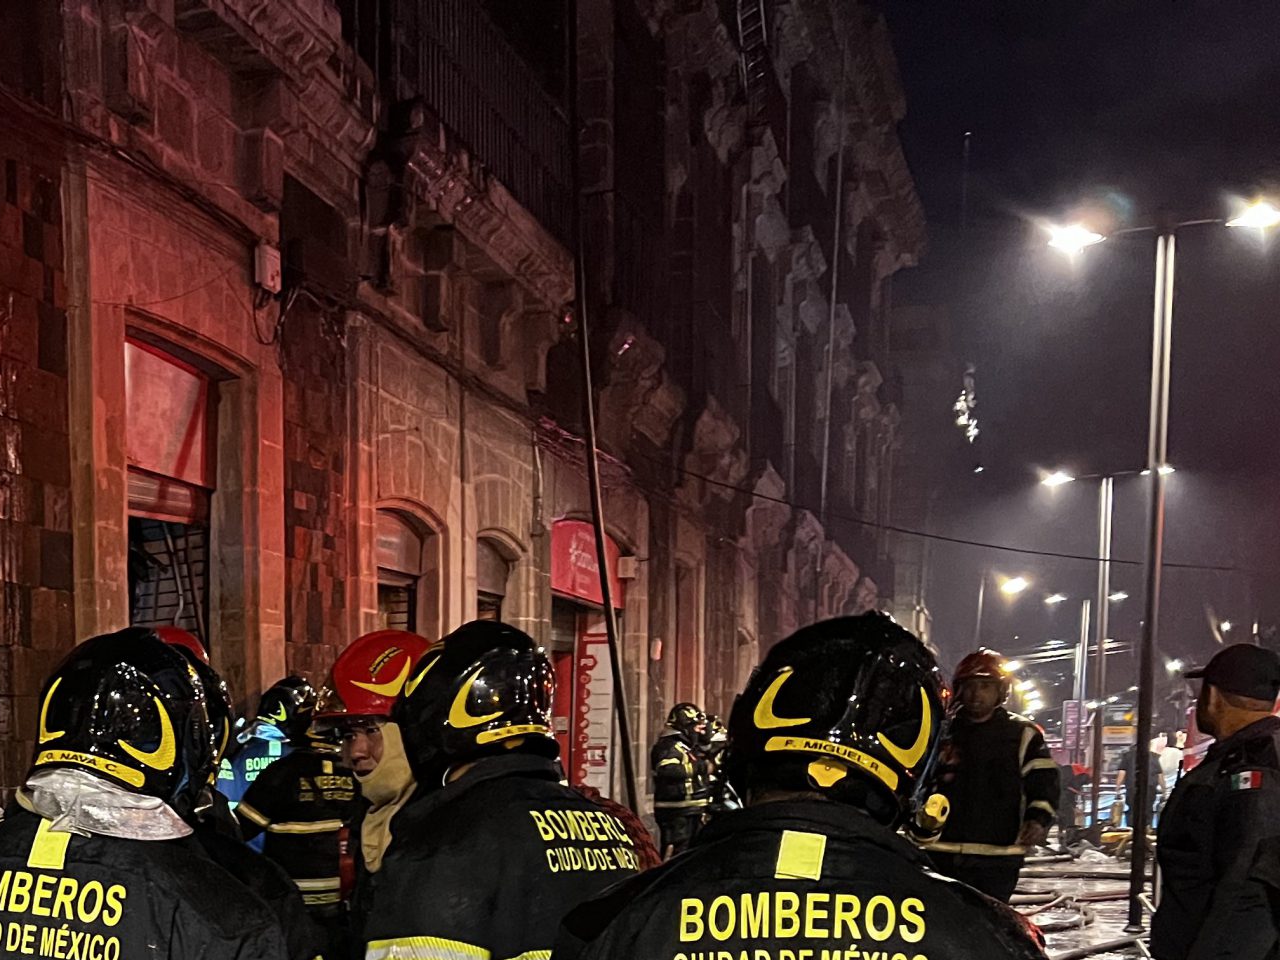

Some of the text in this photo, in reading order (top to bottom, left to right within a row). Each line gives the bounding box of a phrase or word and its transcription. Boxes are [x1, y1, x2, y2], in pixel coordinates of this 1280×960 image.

[60, 752, 98, 766] NAVA
[803, 740, 867, 765] MIGUEL
[679, 891, 926, 943] BOMBEROS
[5, 922, 37, 954] DE
